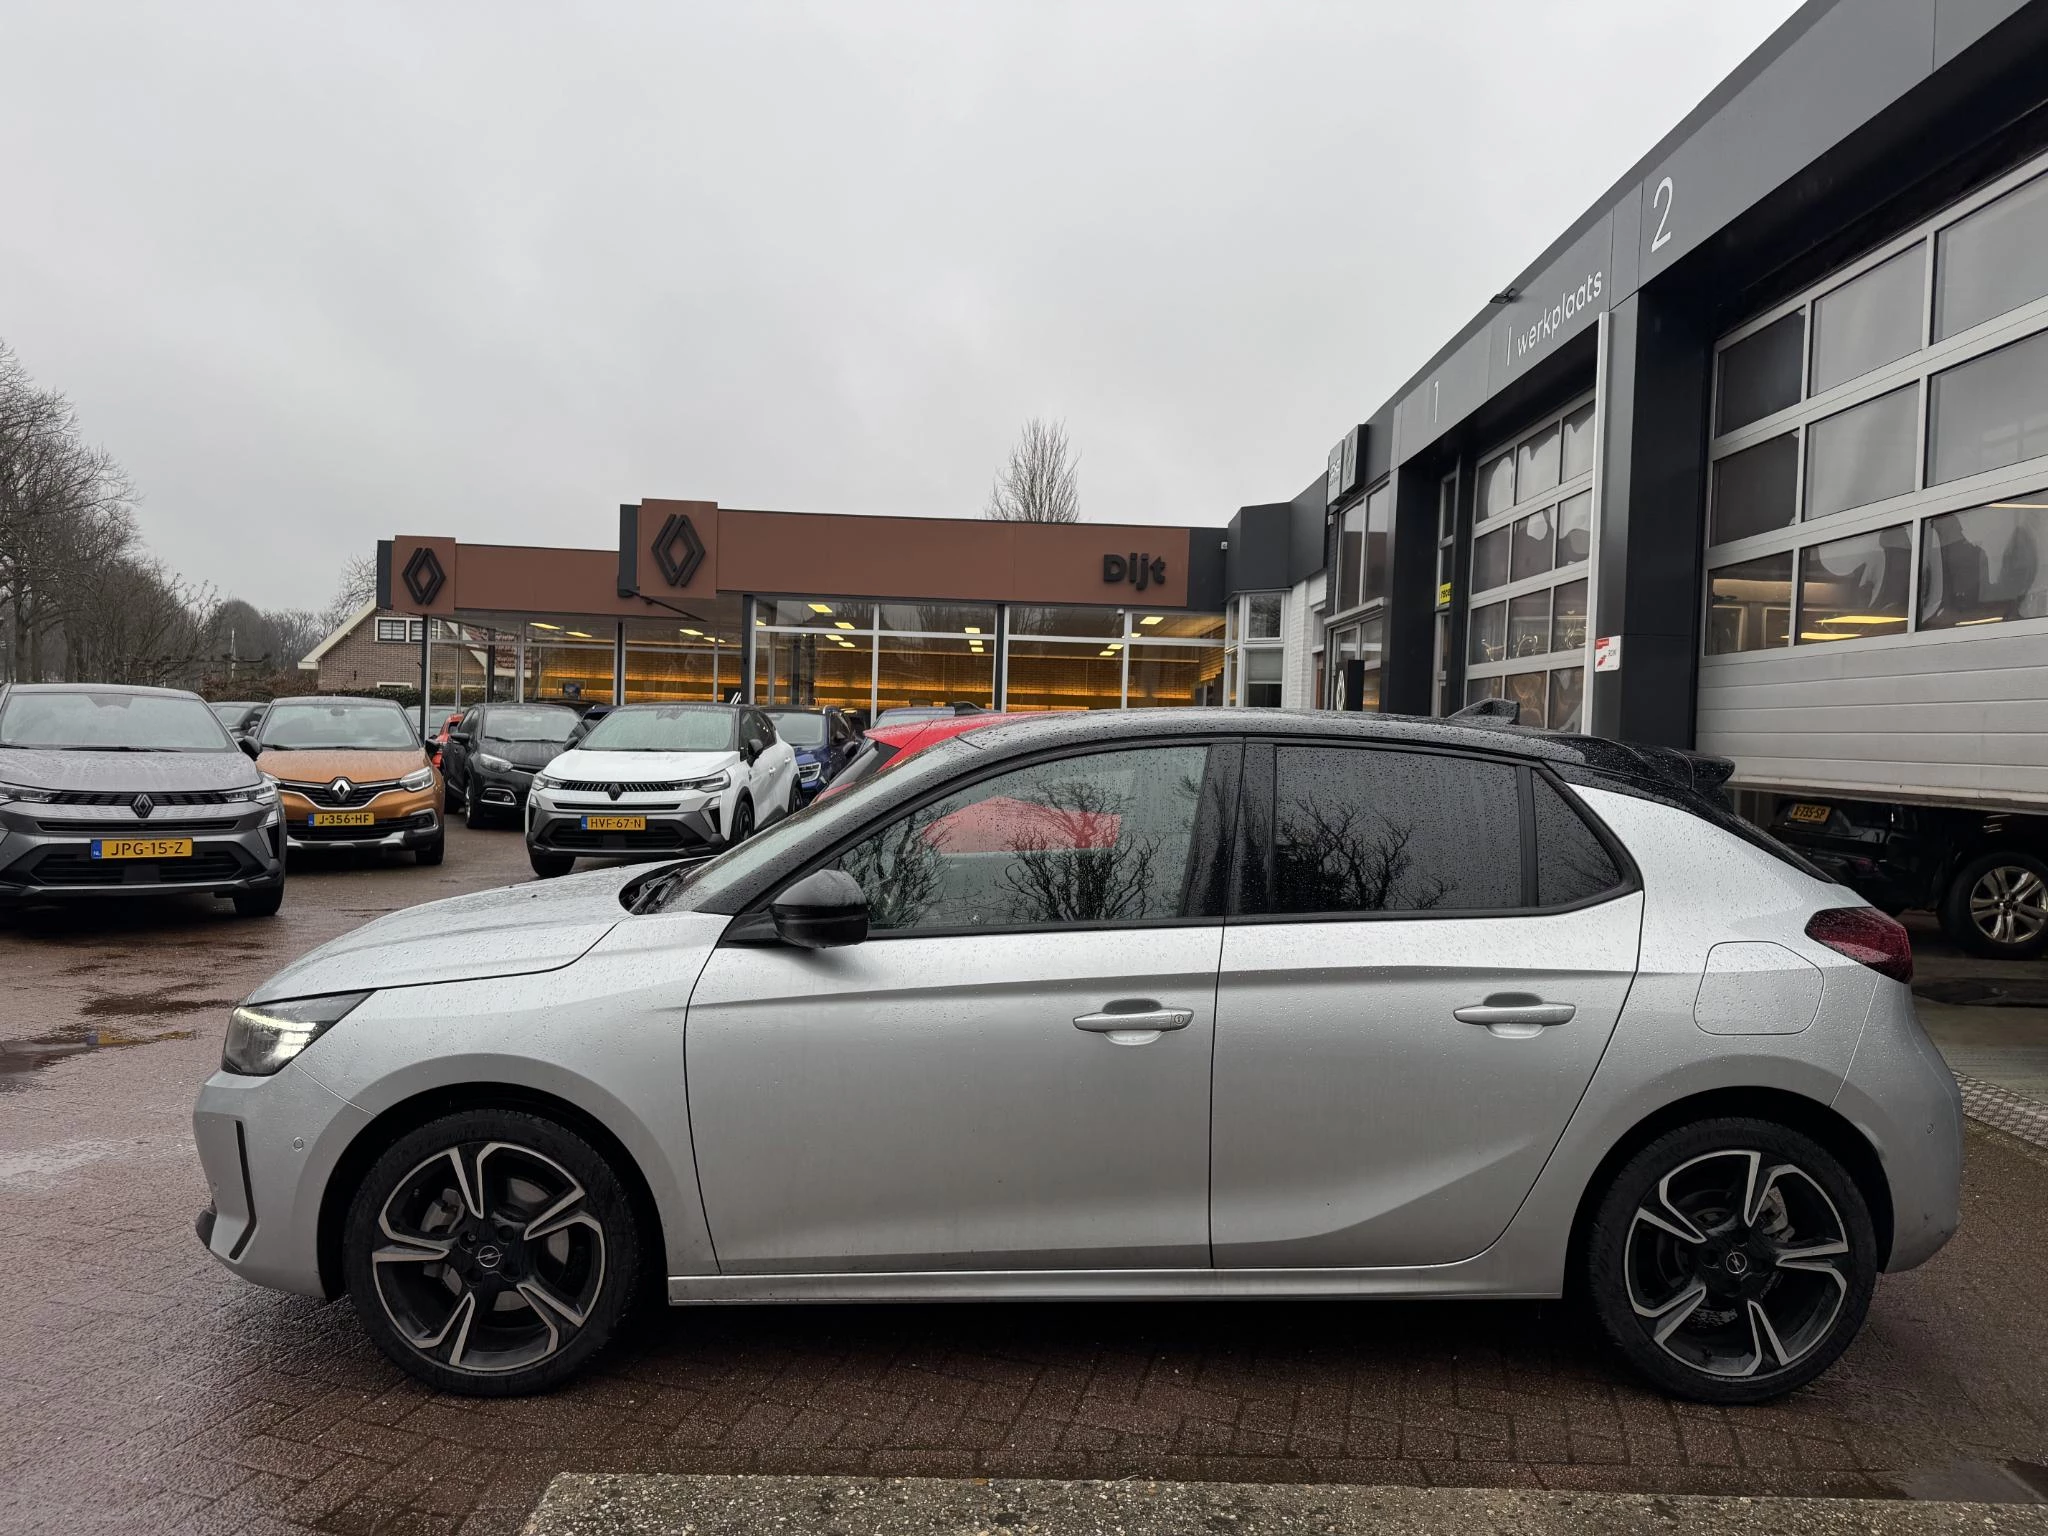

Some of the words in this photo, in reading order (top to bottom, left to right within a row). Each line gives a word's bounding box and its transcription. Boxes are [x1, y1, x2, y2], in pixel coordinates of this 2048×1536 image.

[1651, 176, 1673, 253] 2
[1517, 271, 1602, 358] werkplaats
[1433, 380, 1440, 424] 1
[1103, 552, 1166, 591] Dijt
[318, 814, 370, 825] J-356-HF
[589, 818, 641, 829] HVF-67-N
[111, 841, 184, 856] JPG-15-Z
